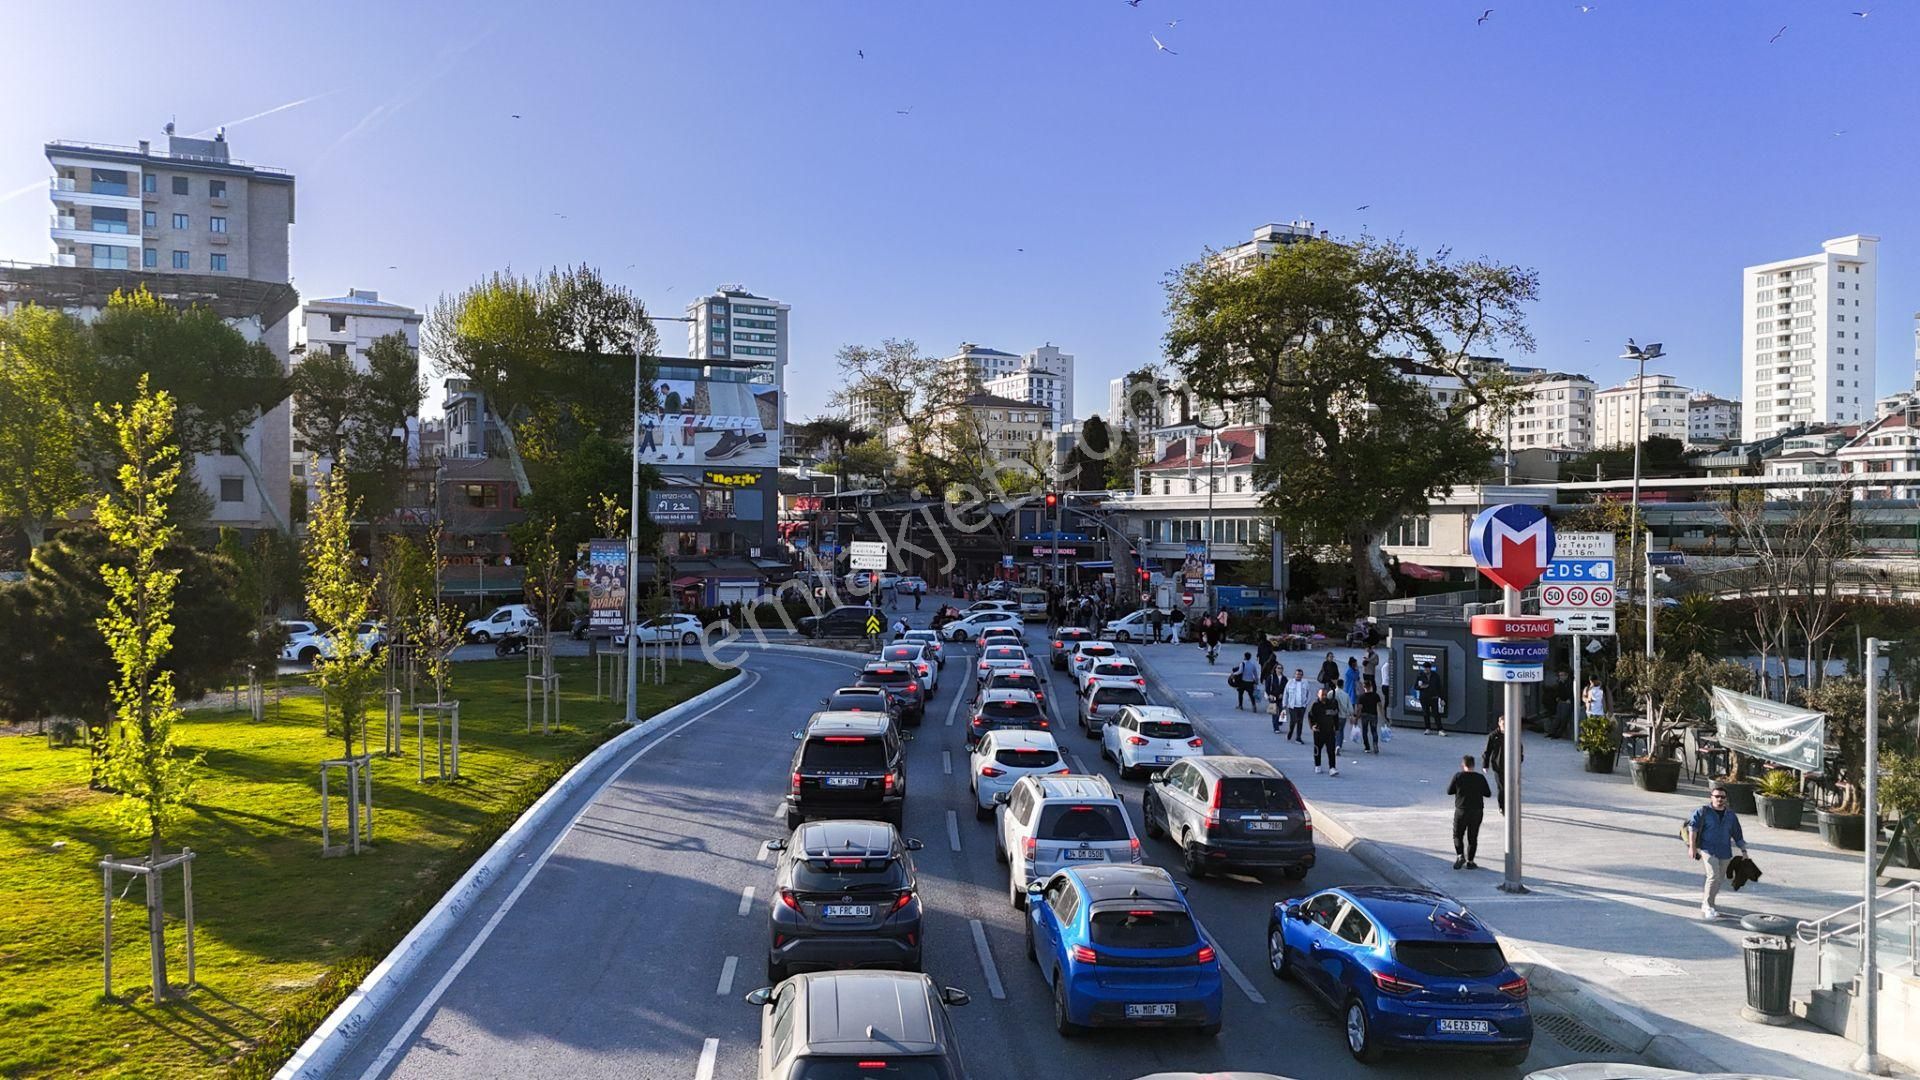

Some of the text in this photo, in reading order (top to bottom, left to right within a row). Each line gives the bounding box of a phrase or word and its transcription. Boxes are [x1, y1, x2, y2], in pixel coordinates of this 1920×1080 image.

[1546, 564, 1584, 578] EDS
[1547, 591, 1560, 601] 50
[1571, 591, 1584, 601] 50
[1595, 592, 1608, 602] 50
[1505, 623, 1550, 633] BOSTANCI
[1491, 647, 1525, 656] BAĞDAT
[1129, 1005, 1139, 1014] 34
[1160, 1004, 1175, 1014] 475
[1441, 1019, 1488, 1031] 34 EZB 573
